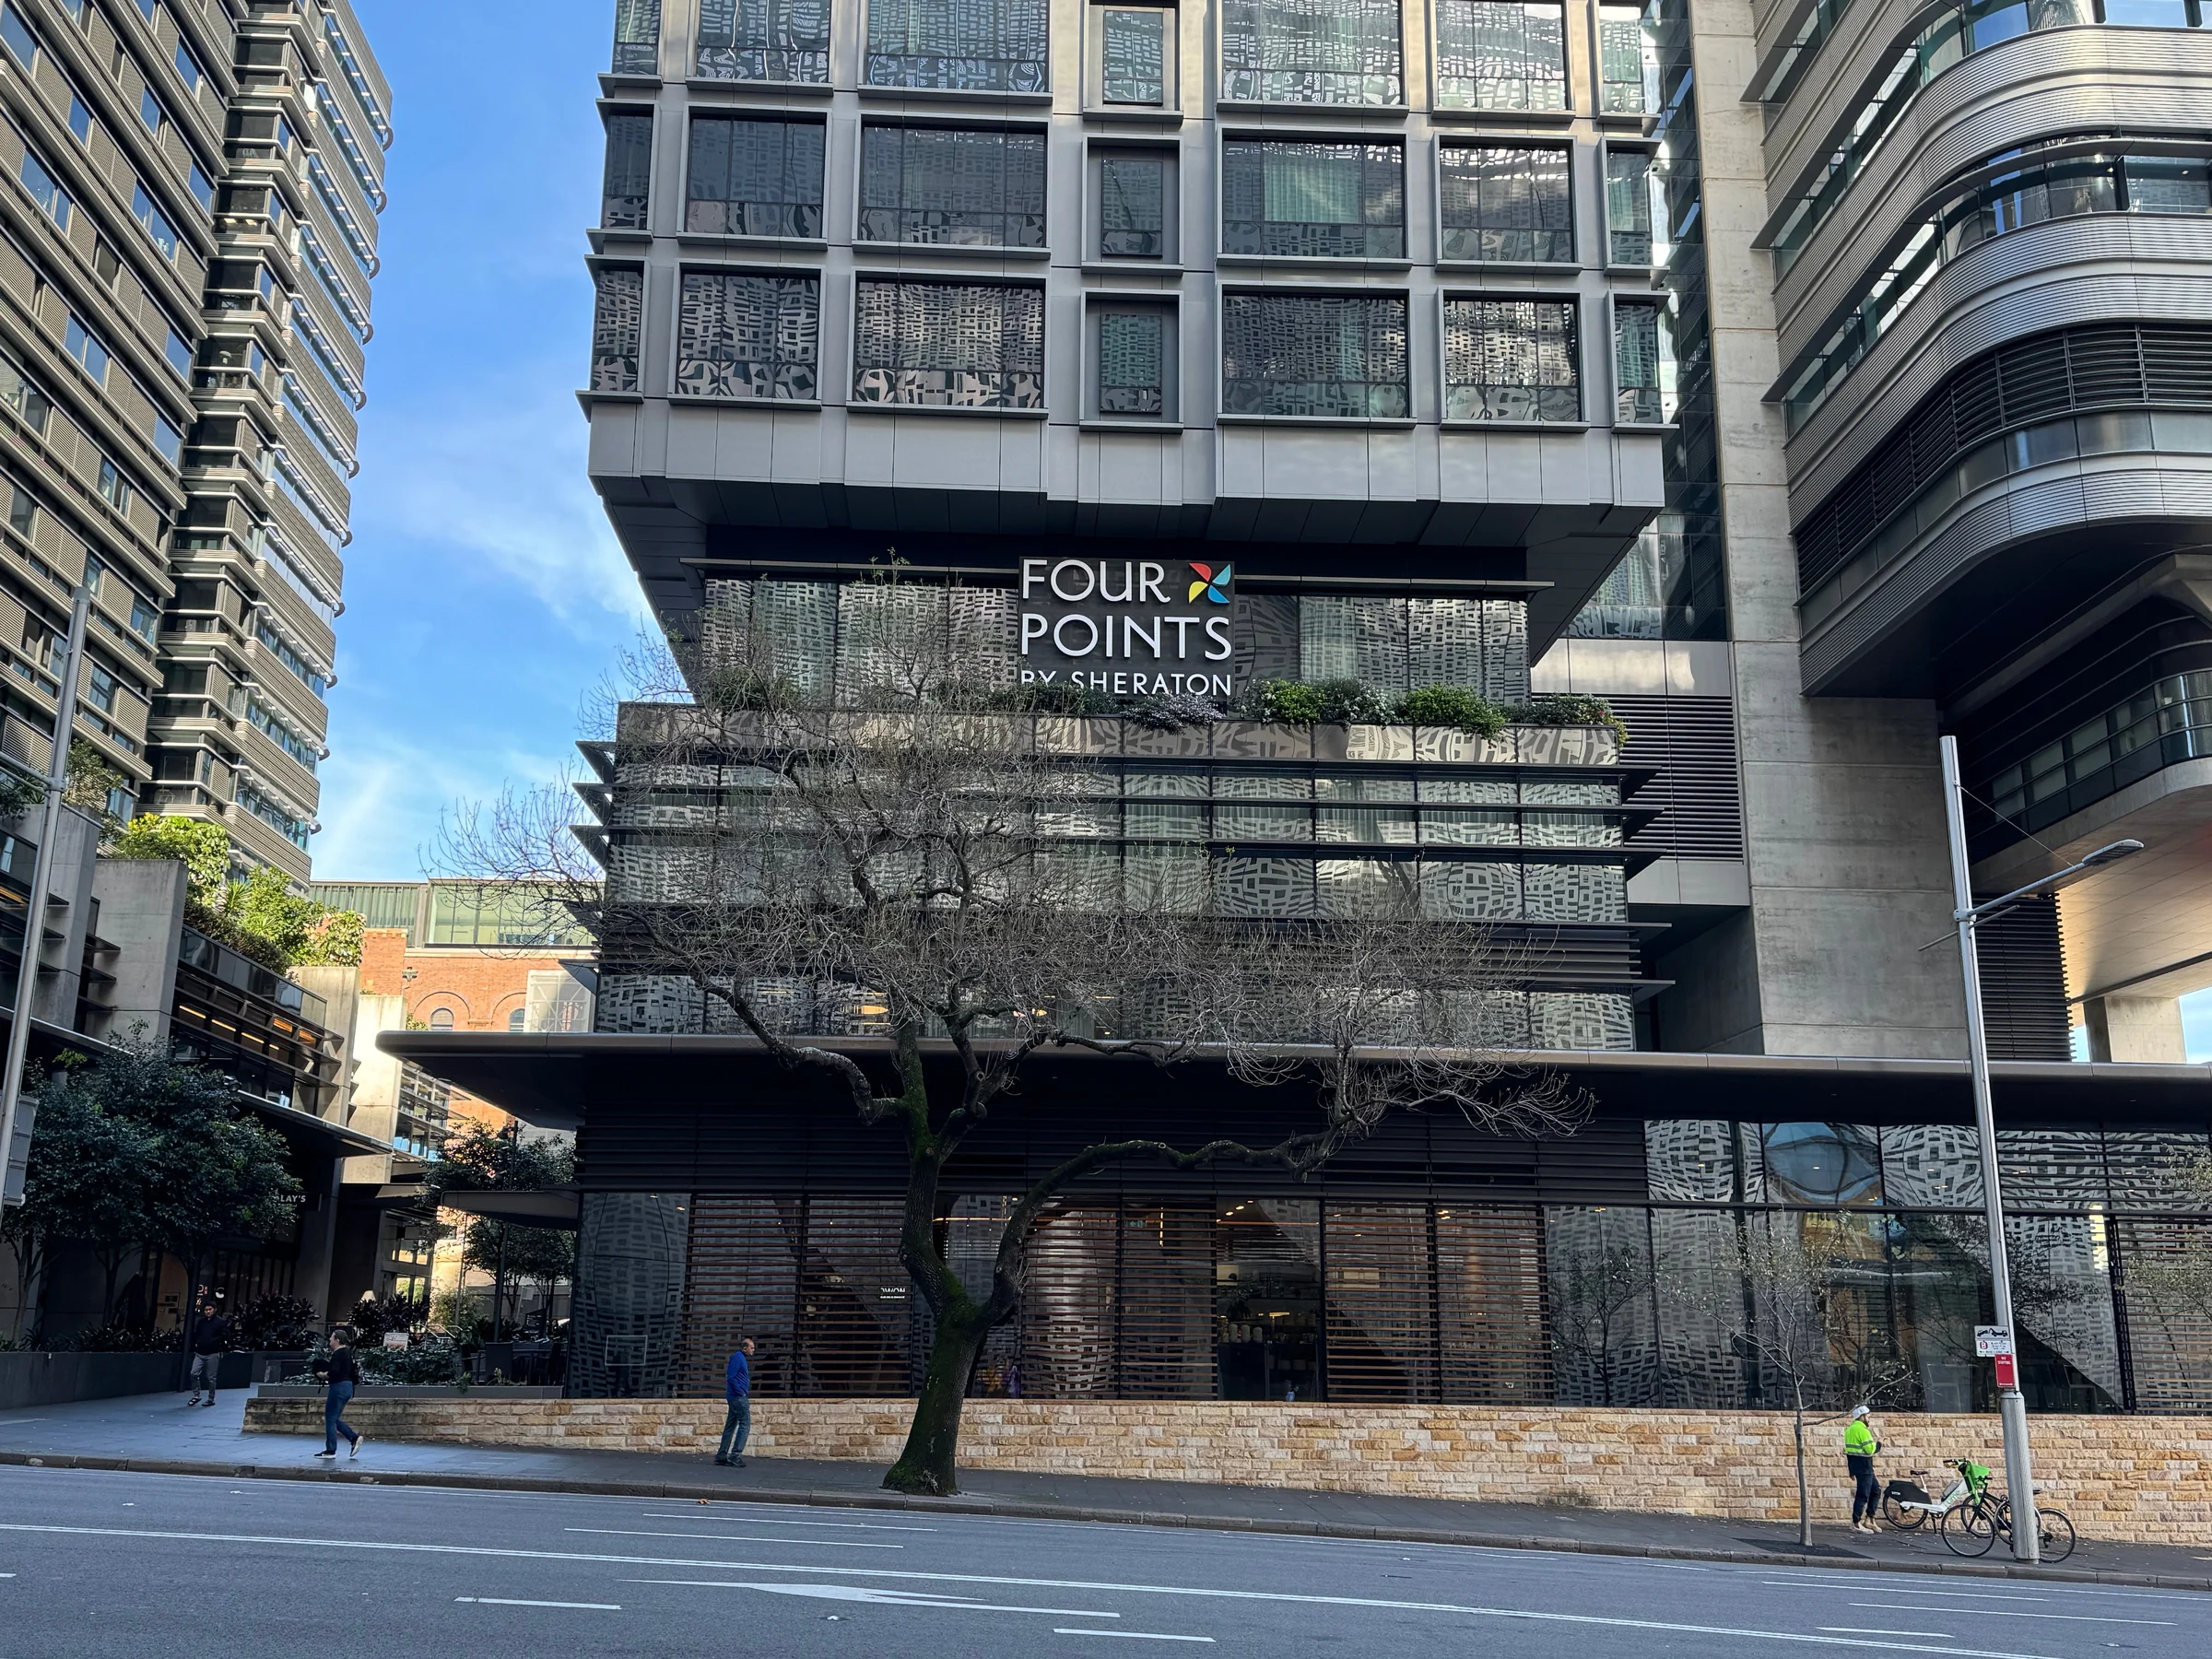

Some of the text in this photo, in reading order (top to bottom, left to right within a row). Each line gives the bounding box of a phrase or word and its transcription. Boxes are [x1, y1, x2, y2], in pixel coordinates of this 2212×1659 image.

[1022, 559, 1171, 603] FOUR
[1021, 613, 1232, 661] POINTS
[1021, 669, 1231, 696] BY SHERATON
